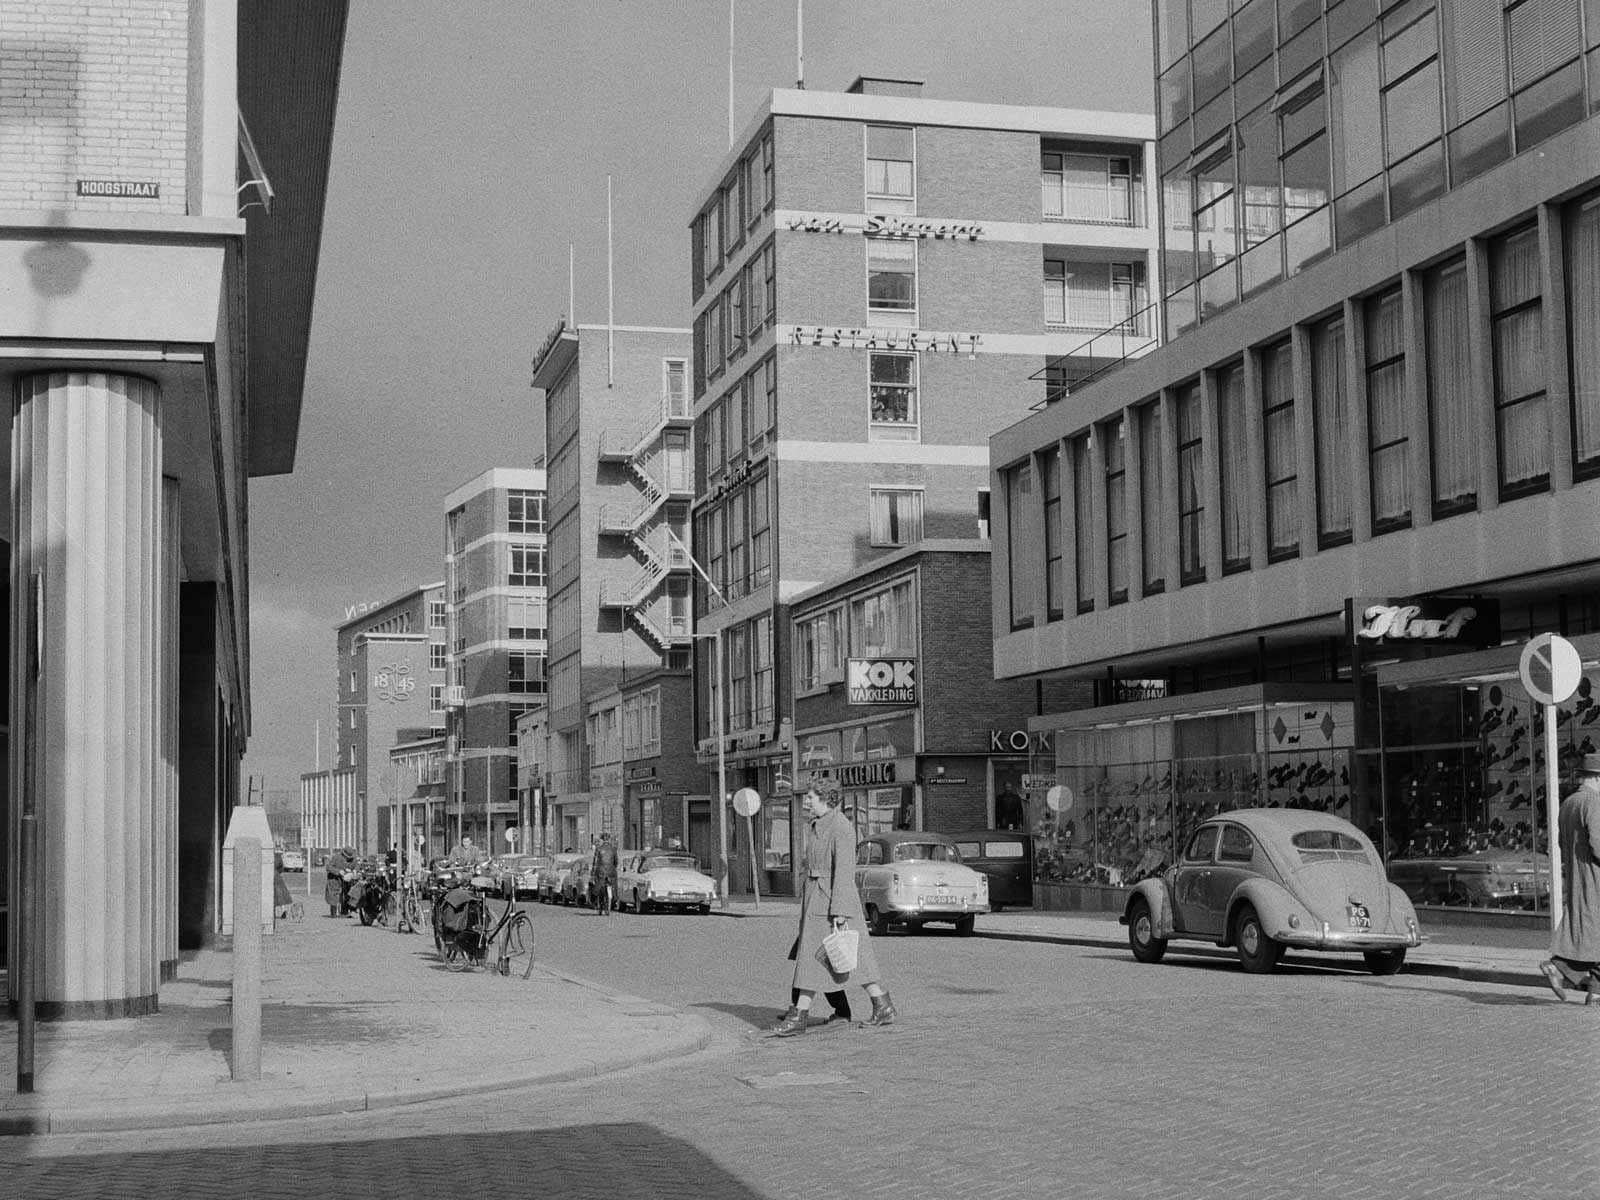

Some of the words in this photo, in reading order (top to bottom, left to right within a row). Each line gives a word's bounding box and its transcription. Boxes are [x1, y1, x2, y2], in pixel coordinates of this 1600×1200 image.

[81, 181, 157, 196] HOOGSTRAAT
[788, 215, 843, 234] van
[791, 326, 983, 353] RESTAURANT
[1359, 605, 1477, 638] Huf
[849, 660, 914, 689] KOK
[850, 688, 914, 702] VAKKLEDING
[990, 729, 1051, 751] KOK
[1352, 906, 1366, 917] PG
